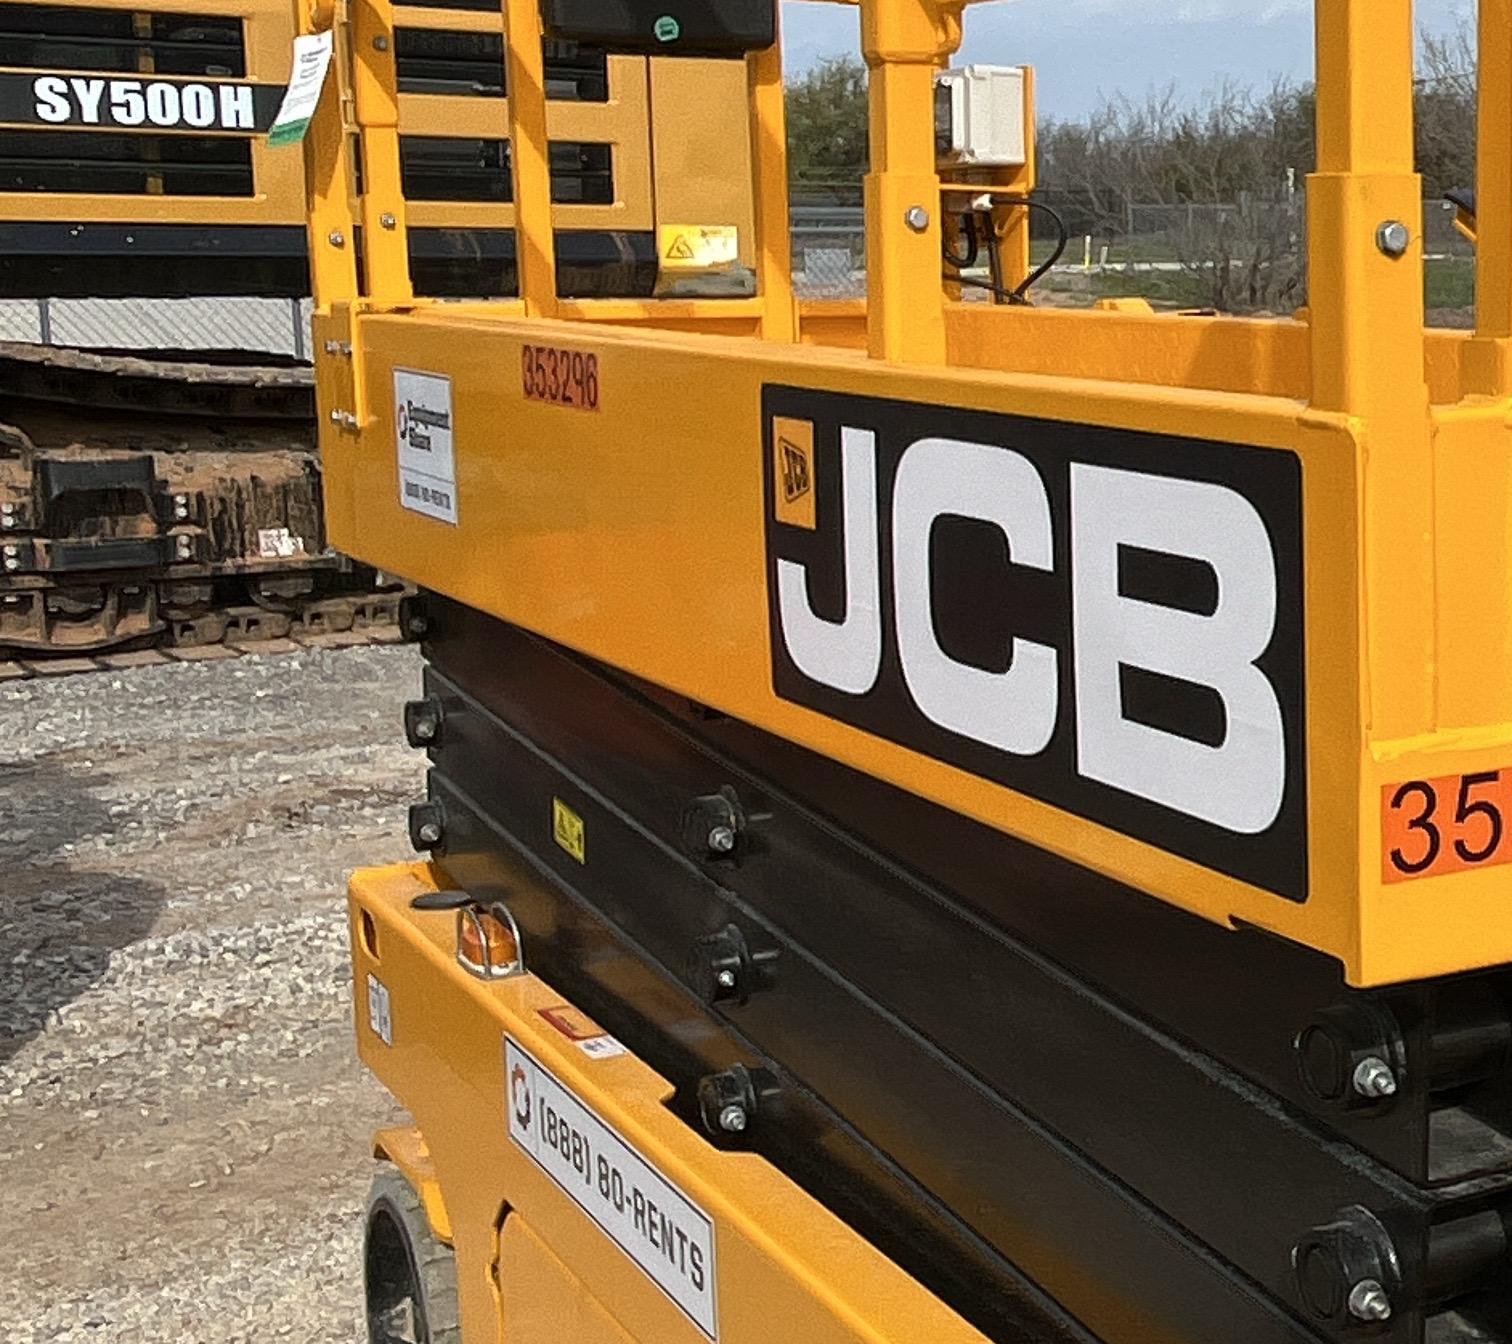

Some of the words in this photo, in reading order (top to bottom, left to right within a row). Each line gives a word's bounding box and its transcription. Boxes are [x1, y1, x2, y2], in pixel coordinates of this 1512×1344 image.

[33, 76, 255, 129] SY500H
[522, 343, 599, 408] 353296
[777, 425, 1286, 834] JCB
